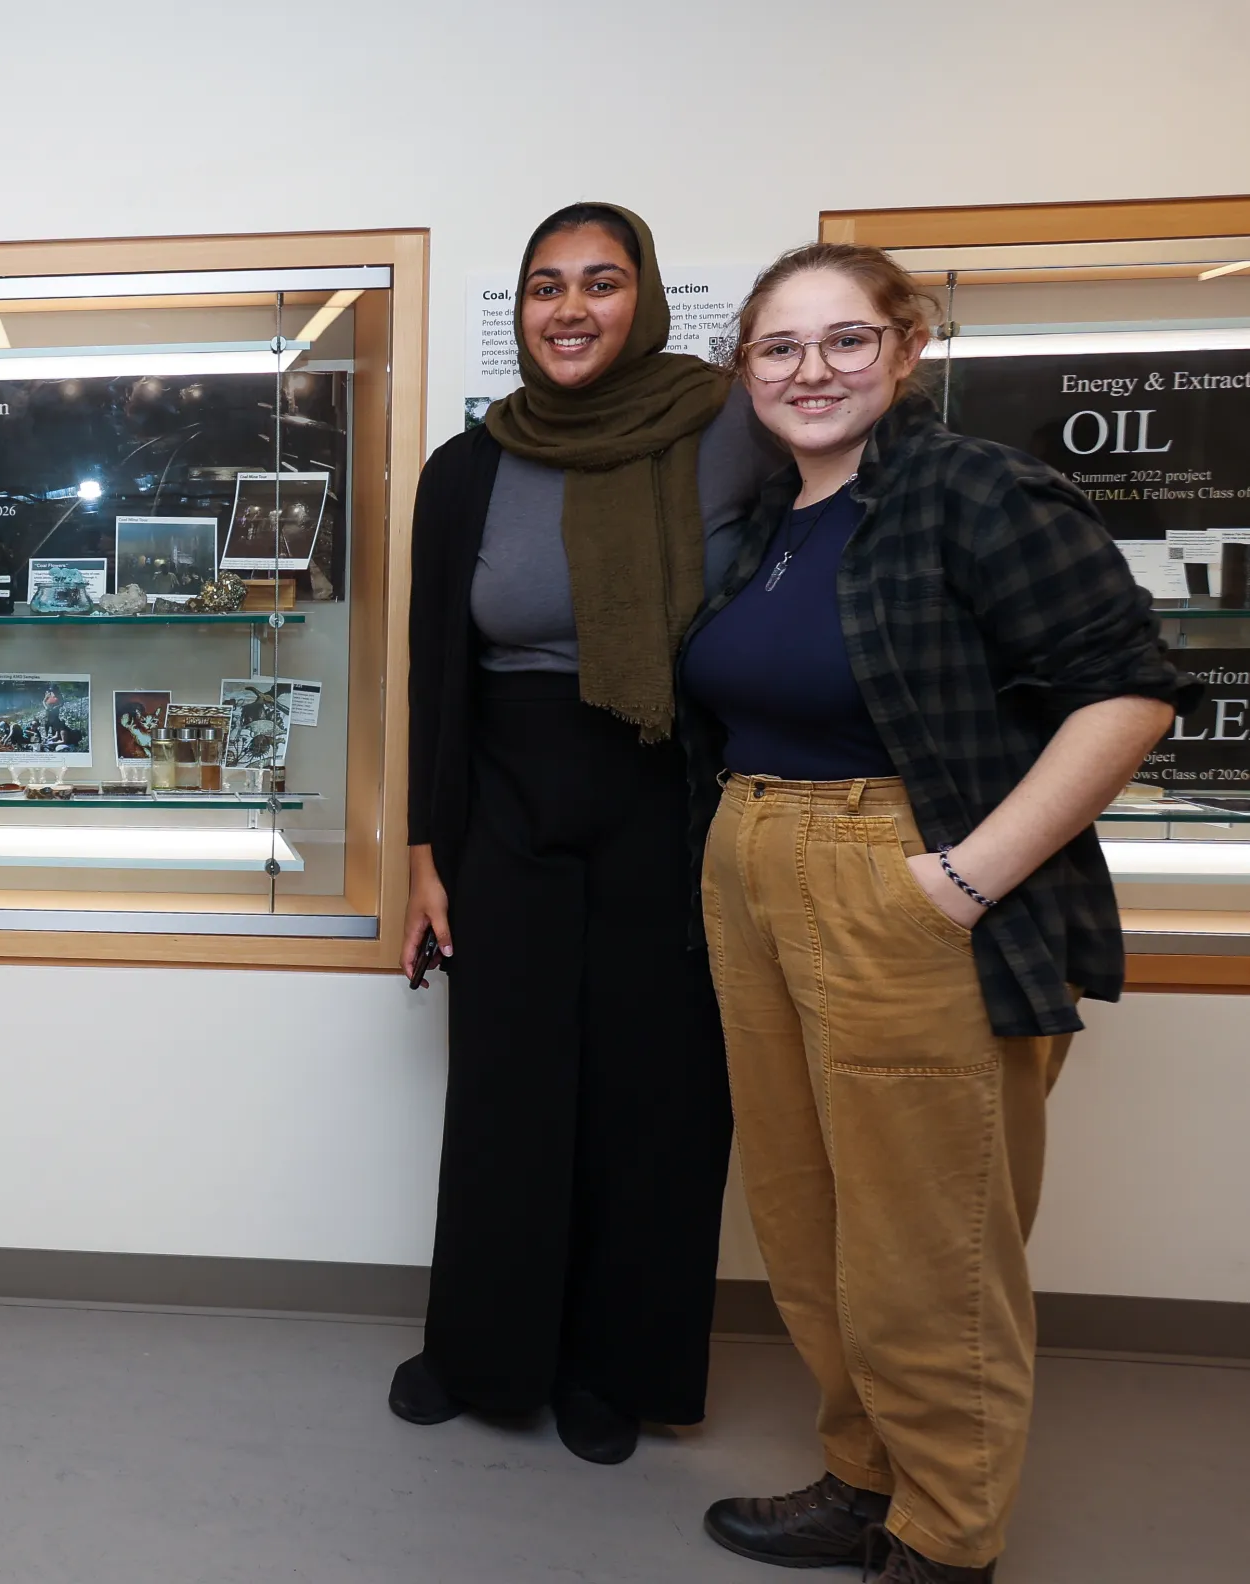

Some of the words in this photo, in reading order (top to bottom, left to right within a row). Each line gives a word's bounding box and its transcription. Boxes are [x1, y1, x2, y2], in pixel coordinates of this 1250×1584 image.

[483, 289, 512, 301] Coal,
[682, 302, 691, 312] by
[693, 302, 725, 310] students
[726, 301, 734, 309] in
[482, 319, 515, 327] Professor
[685, 312, 697, 320] the
[481, 329, 512, 337] iteration
[684, 322, 698, 330] The
[698, 321, 729, 330] STEMLA
[481, 338, 508, 346] Fellows
[481, 358, 499, 366] wide
[481, 367, 511, 376] multiple
[1060, 374, 1139, 397] Energy
[1144, 372, 1166, 391] &
[1062, 409, 1174, 455] OIL
[1071, 471, 1129, 484] Summer
[1129, 470, 1162, 483] 2022
[1165, 468, 1213, 484] project
[1081, 488, 1140, 501] TEMLA
[1142, 487, 1195, 500] Fellows
[1197, 486, 1235, 500] Class
[1187, 666, 1250, 685] ction
[1167, 698, 1250, 741] LE
[1131, 770, 1159, 780] ows
[1161, 768, 1197, 780] Class
[1199, 768, 1217, 780] of
[1217, 768, 1250, 780] 2026
